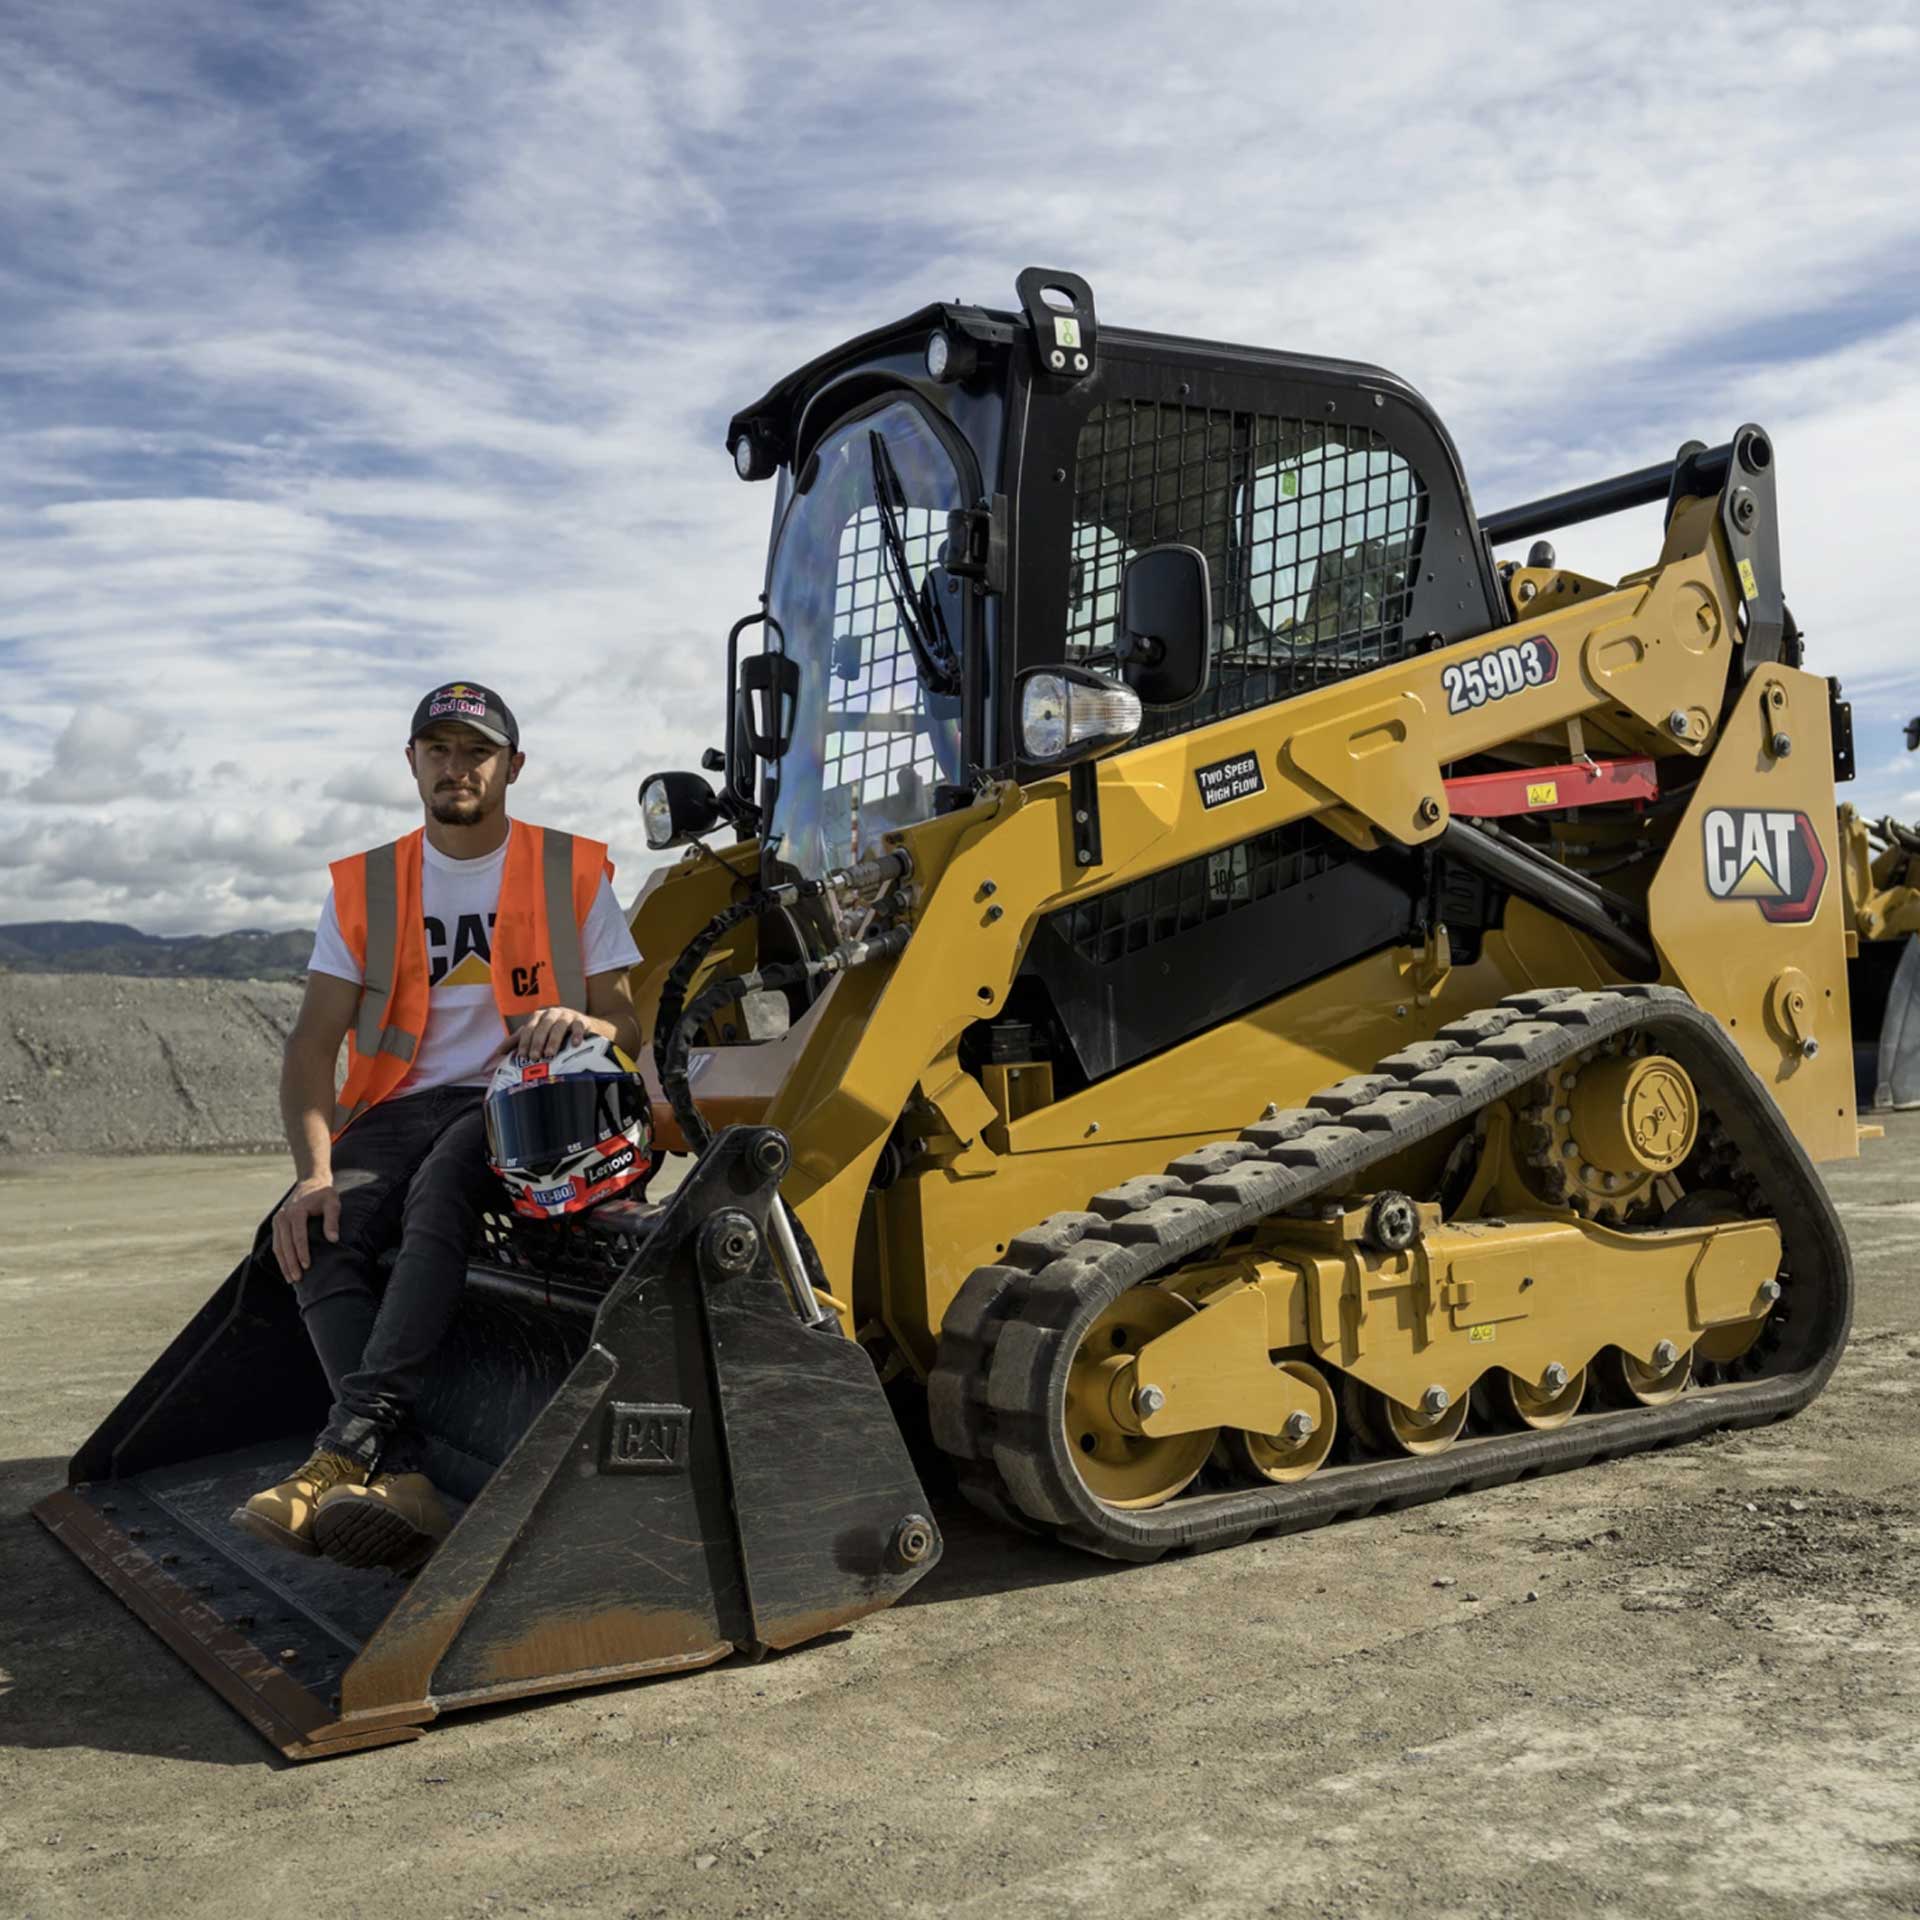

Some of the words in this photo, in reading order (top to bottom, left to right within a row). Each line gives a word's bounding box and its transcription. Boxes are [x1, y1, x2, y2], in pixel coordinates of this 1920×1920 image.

[1442, 640, 1544, 714] 259D3
[429, 699, 456, 717] Red
[457, 699, 486, 717] Bull
[1705, 810, 1796, 896] CAT
[424, 913, 497, 988] CA
[512, 961, 546, 997] CA
[588, 1151, 634, 1182] Lenovo
[617, 1417, 682, 1462] CAT
